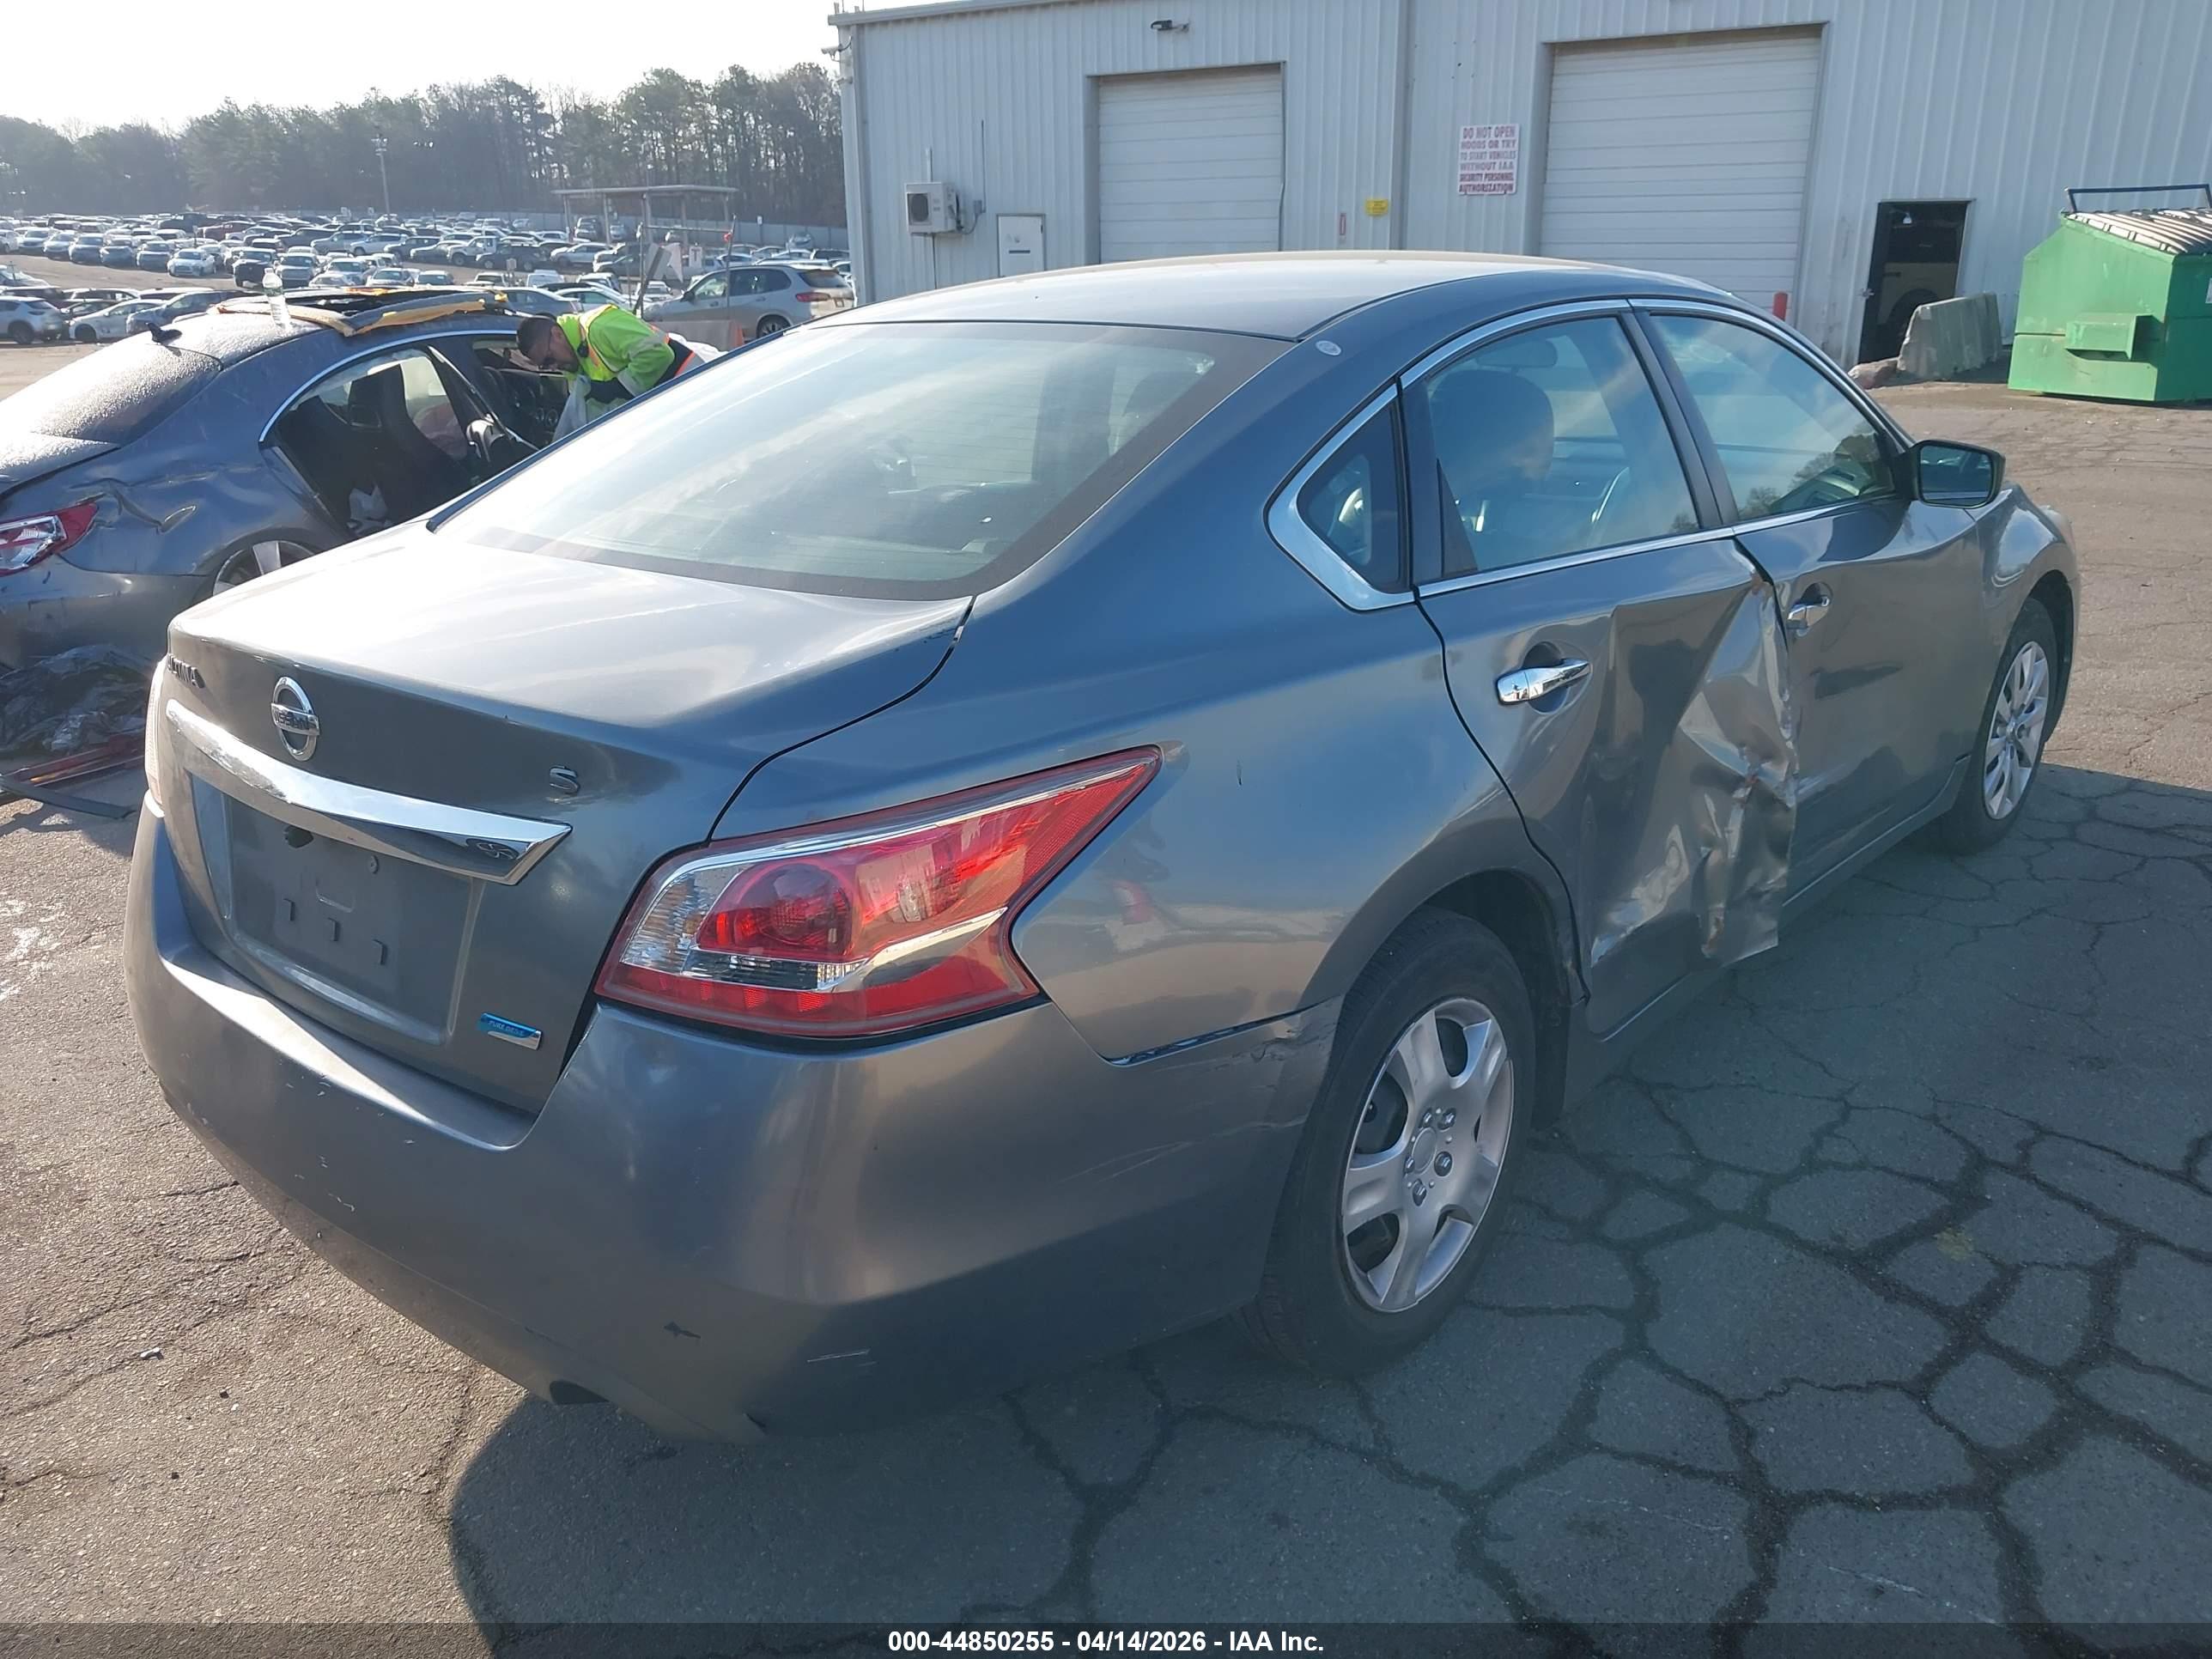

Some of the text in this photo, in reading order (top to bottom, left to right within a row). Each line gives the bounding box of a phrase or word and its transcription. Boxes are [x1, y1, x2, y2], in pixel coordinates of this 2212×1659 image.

[1463, 126, 1515, 139] DO NOT OPEN
[1461, 139, 1516, 149] HOODS OR TRY
[1461, 162, 1496, 171] WITHOUT
[1459, 184, 1513, 192] AUTHORIZATION
[550, 765, 580, 794] S
